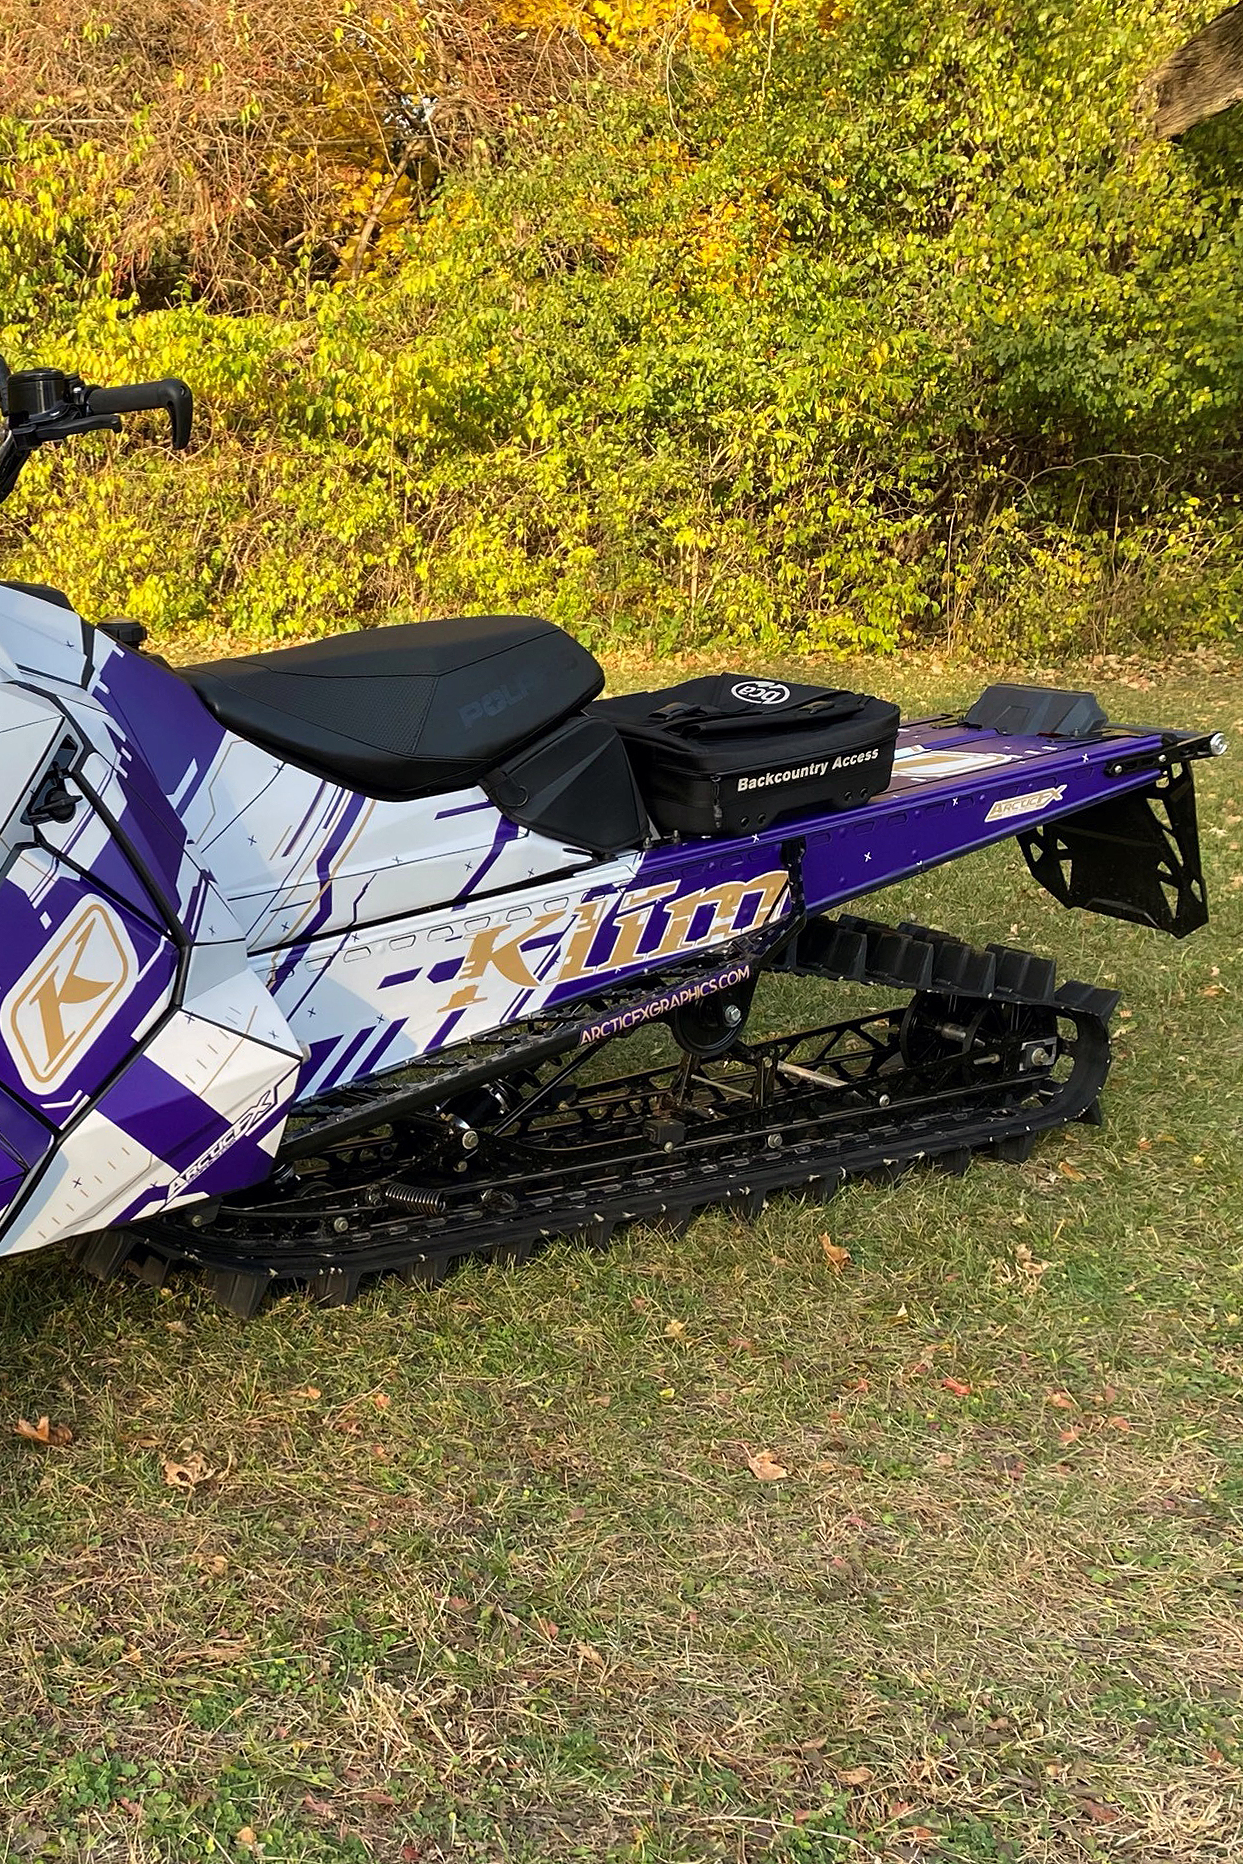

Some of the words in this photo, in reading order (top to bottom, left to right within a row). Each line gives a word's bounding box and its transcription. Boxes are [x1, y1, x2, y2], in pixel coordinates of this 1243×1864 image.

[738, 686, 781, 703] bca
[737, 761, 829, 792] Backcountry
[832, 748, 879, 770] Access
[437, 870, 791, 1013] Klim
[580, 966, 750, 1046] ARCTICFXGRAPHICS.COM
